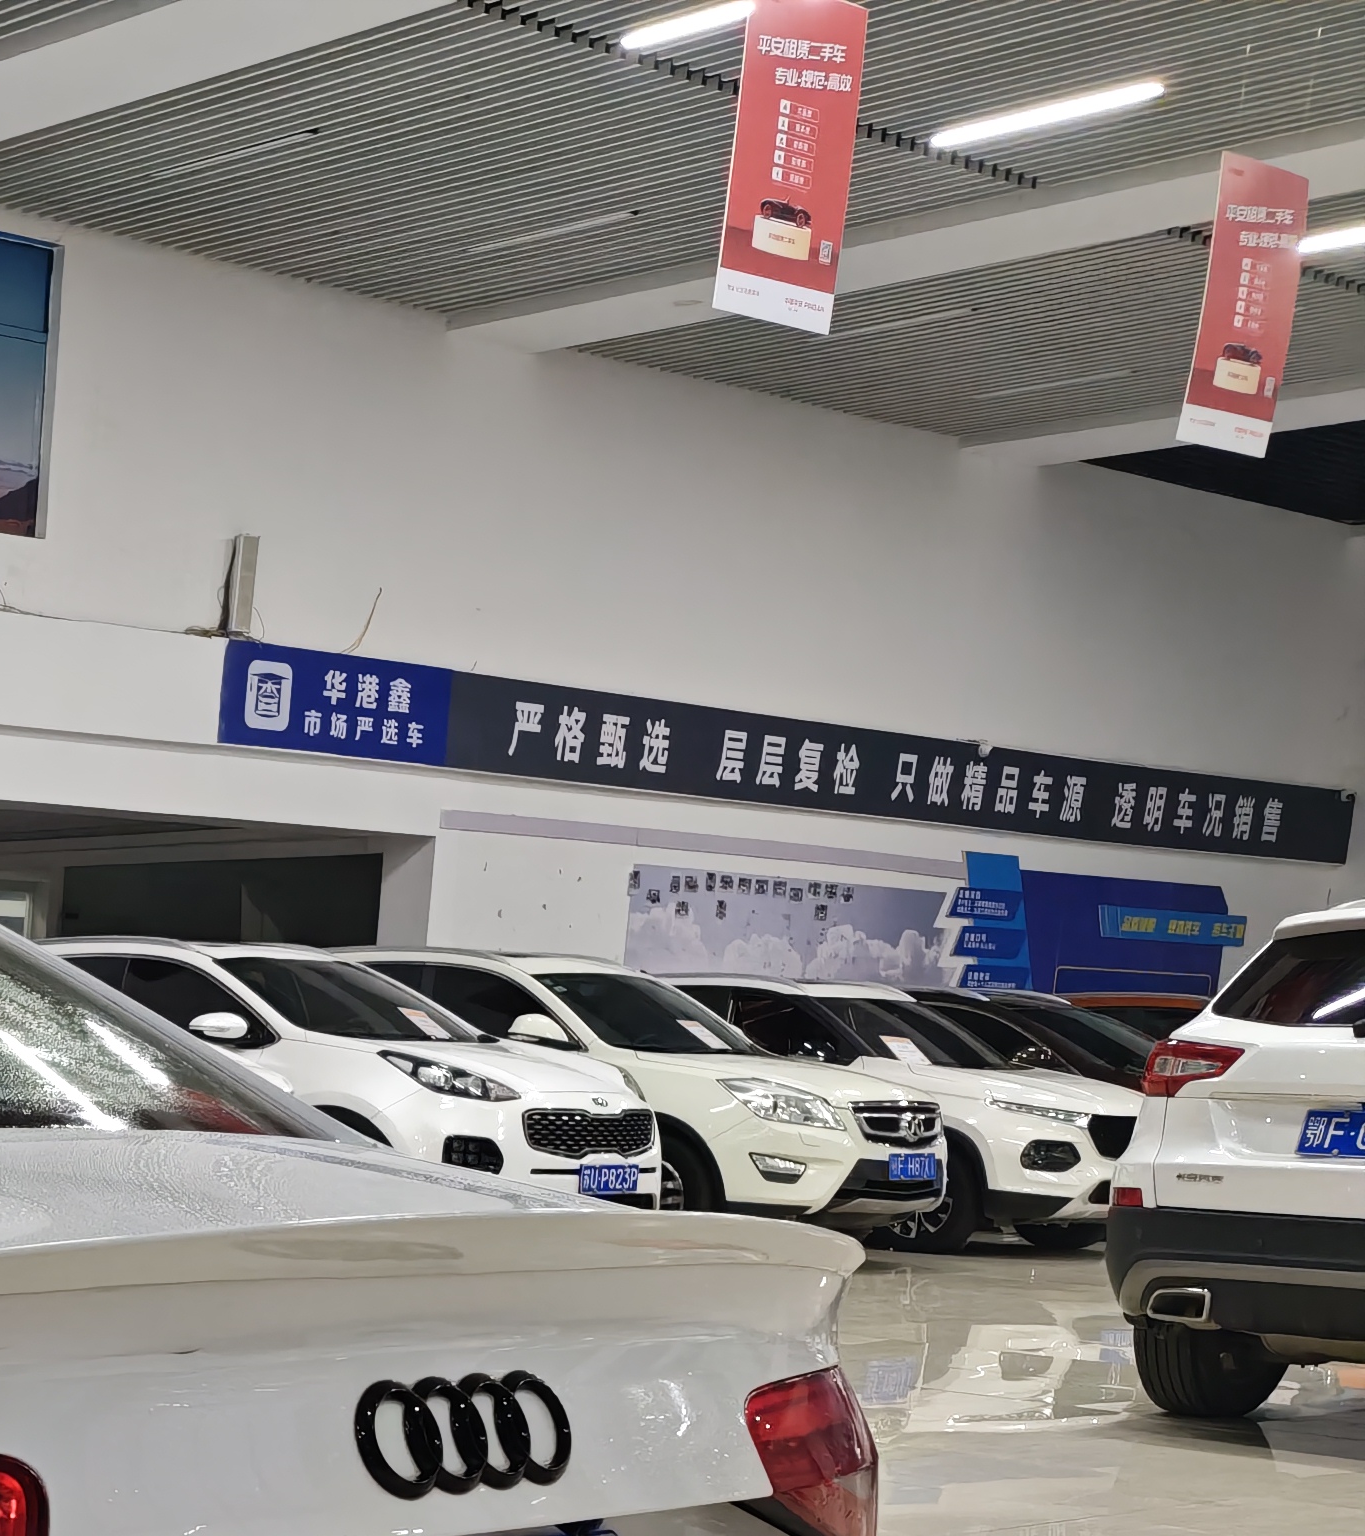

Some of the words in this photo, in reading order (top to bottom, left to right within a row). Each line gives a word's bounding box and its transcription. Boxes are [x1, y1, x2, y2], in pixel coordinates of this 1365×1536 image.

[757, 34, 847, 63] 平安租赁二手车
[323, 669, 412, 714] 华港鑫
[304, 709, 424, 748] 市场严选车
[508, 701, 671, 774] 严格甄选
[715, 729, 860, 795] 层层复检
[890, 752, 1087, 823] 只做精品车源
[1110, 782, 1284, 843] 透明车况销售
